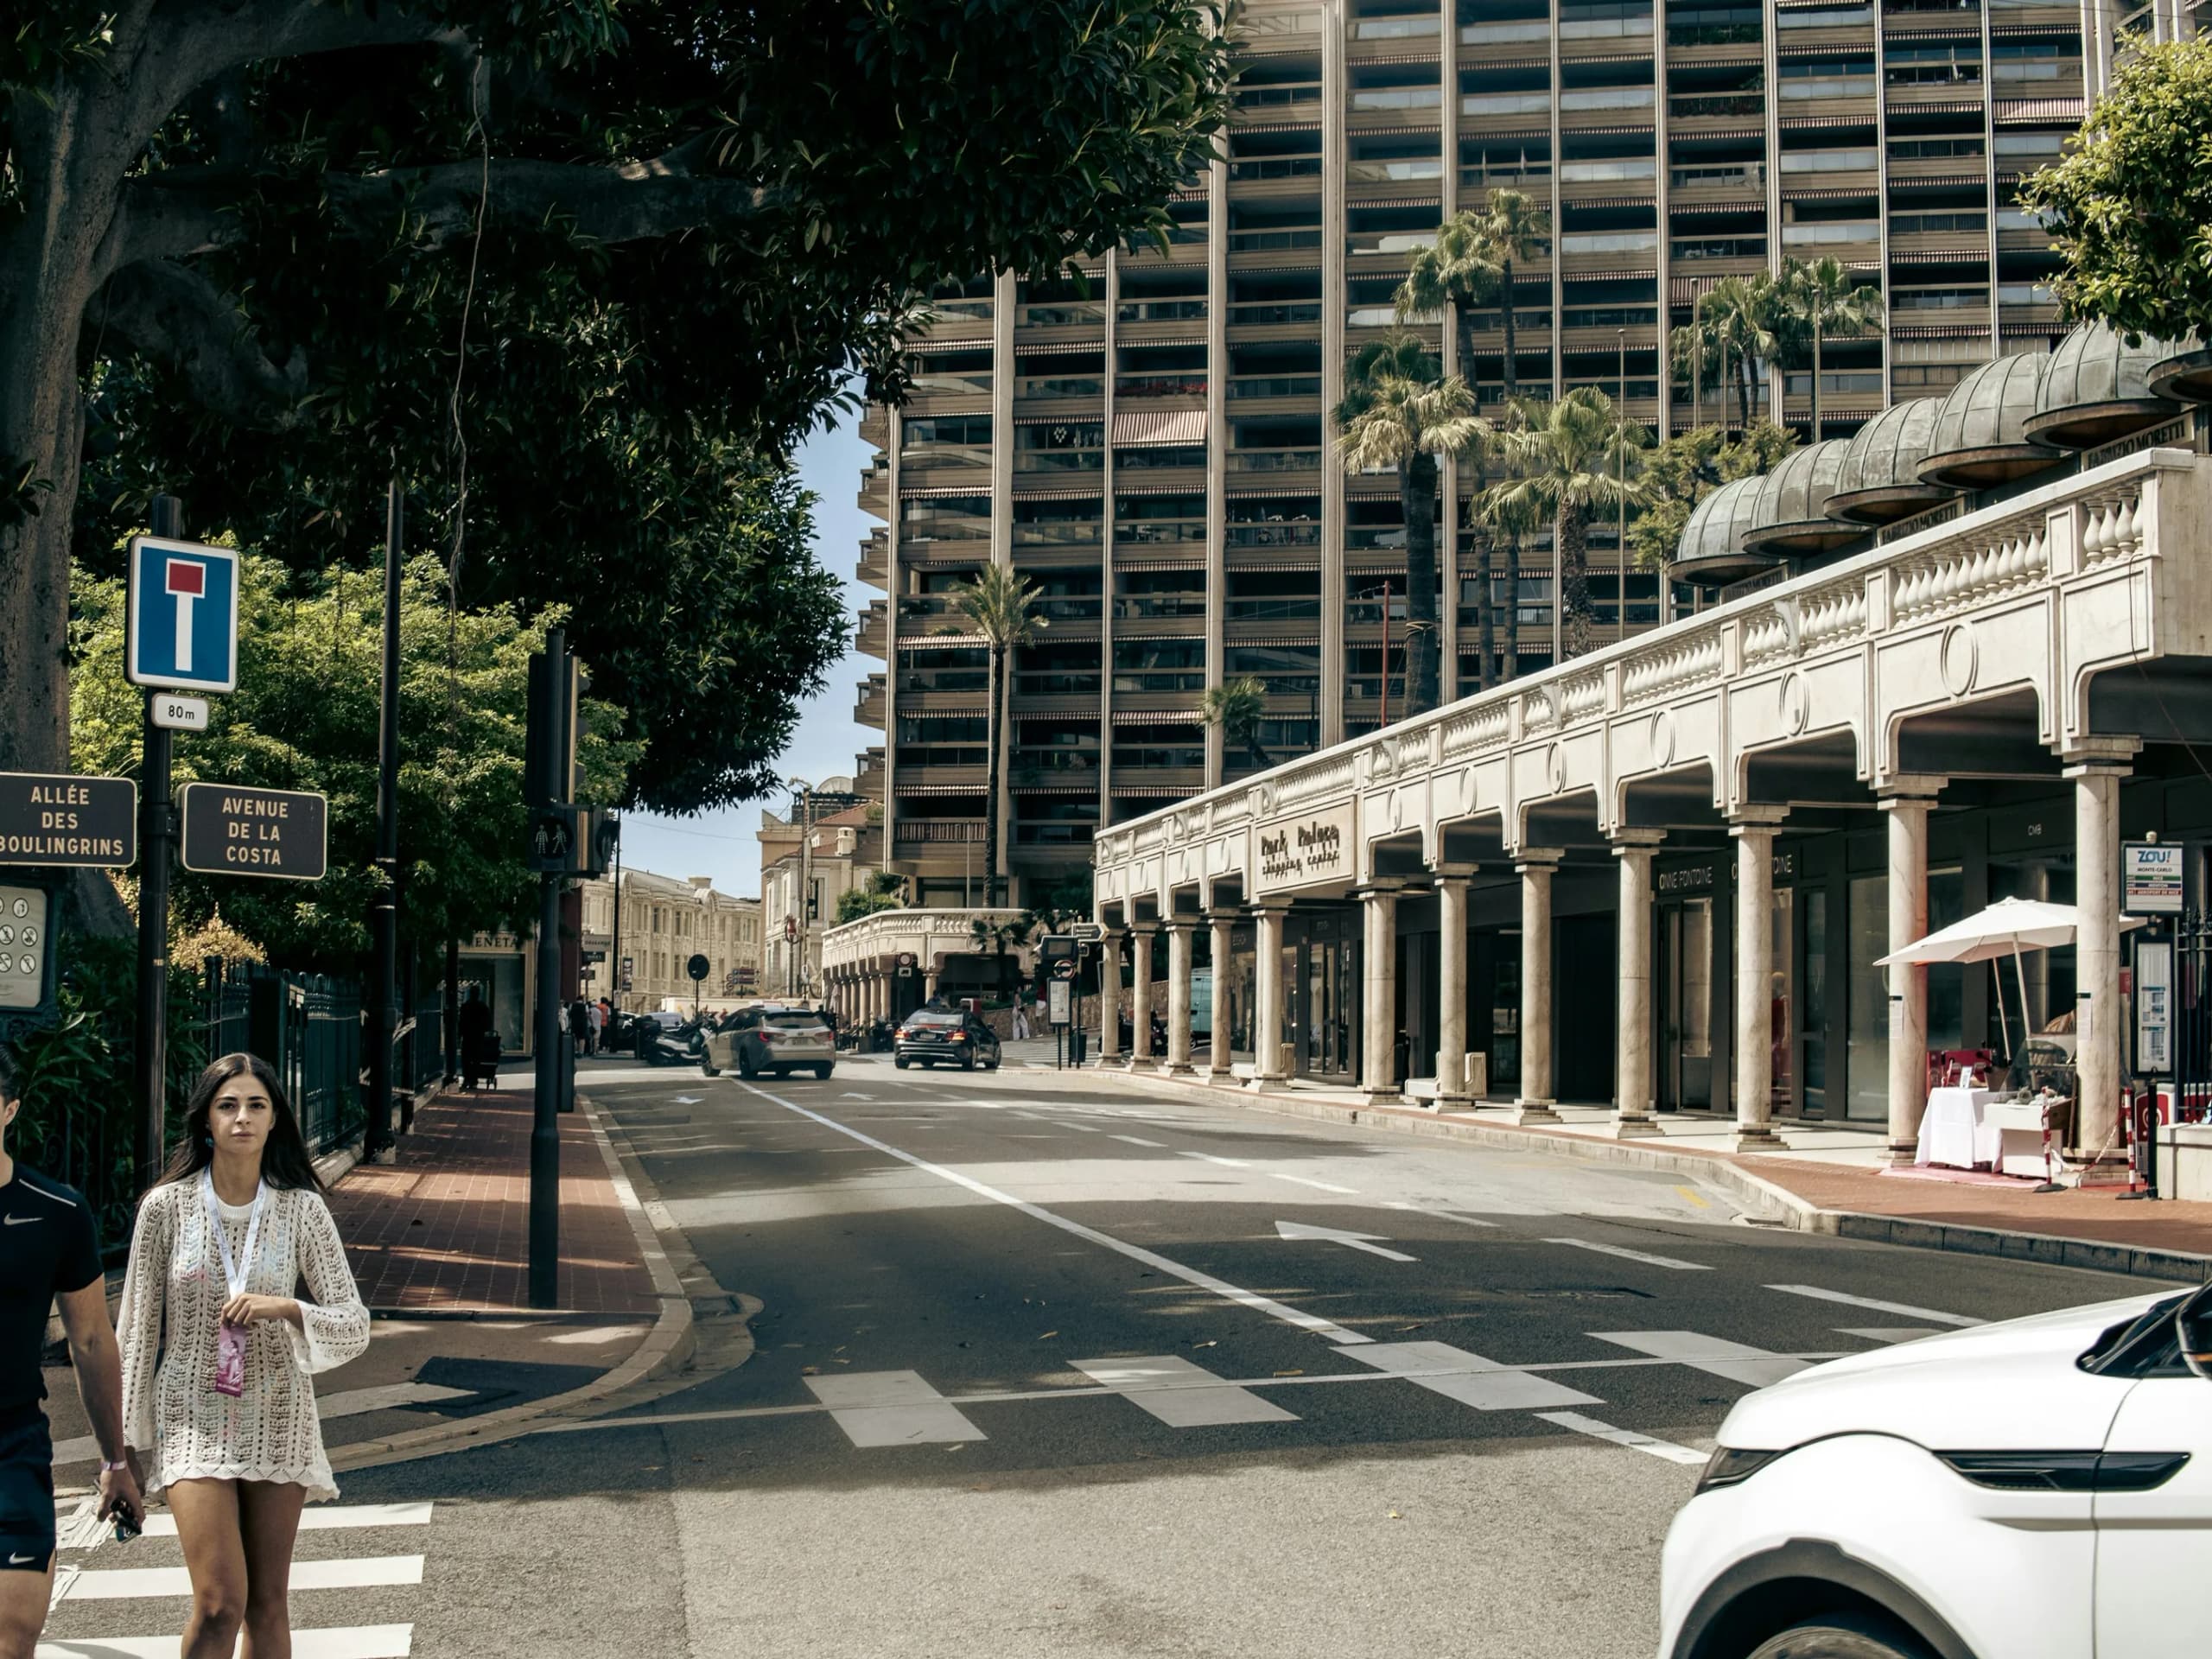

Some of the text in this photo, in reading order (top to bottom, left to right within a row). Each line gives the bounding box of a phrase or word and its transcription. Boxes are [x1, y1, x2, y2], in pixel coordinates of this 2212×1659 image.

[2135, 420, 2185, 449] MORETTI
[168, 704, 195, 720] 80m
[30, 784, 90, 805] ALLÉE
[222, 797, 289, 818] AVENUE
[41, 811, 79, 830] DES
[228, 822, 281, 842] DE LA
[0, 836, 124, 856] BOULINGRINS
[226, 846, 282, 865] COSTA
[2137, 850, 2171, 863] ZOU!
[474, 937, 517, 948] ENETA
